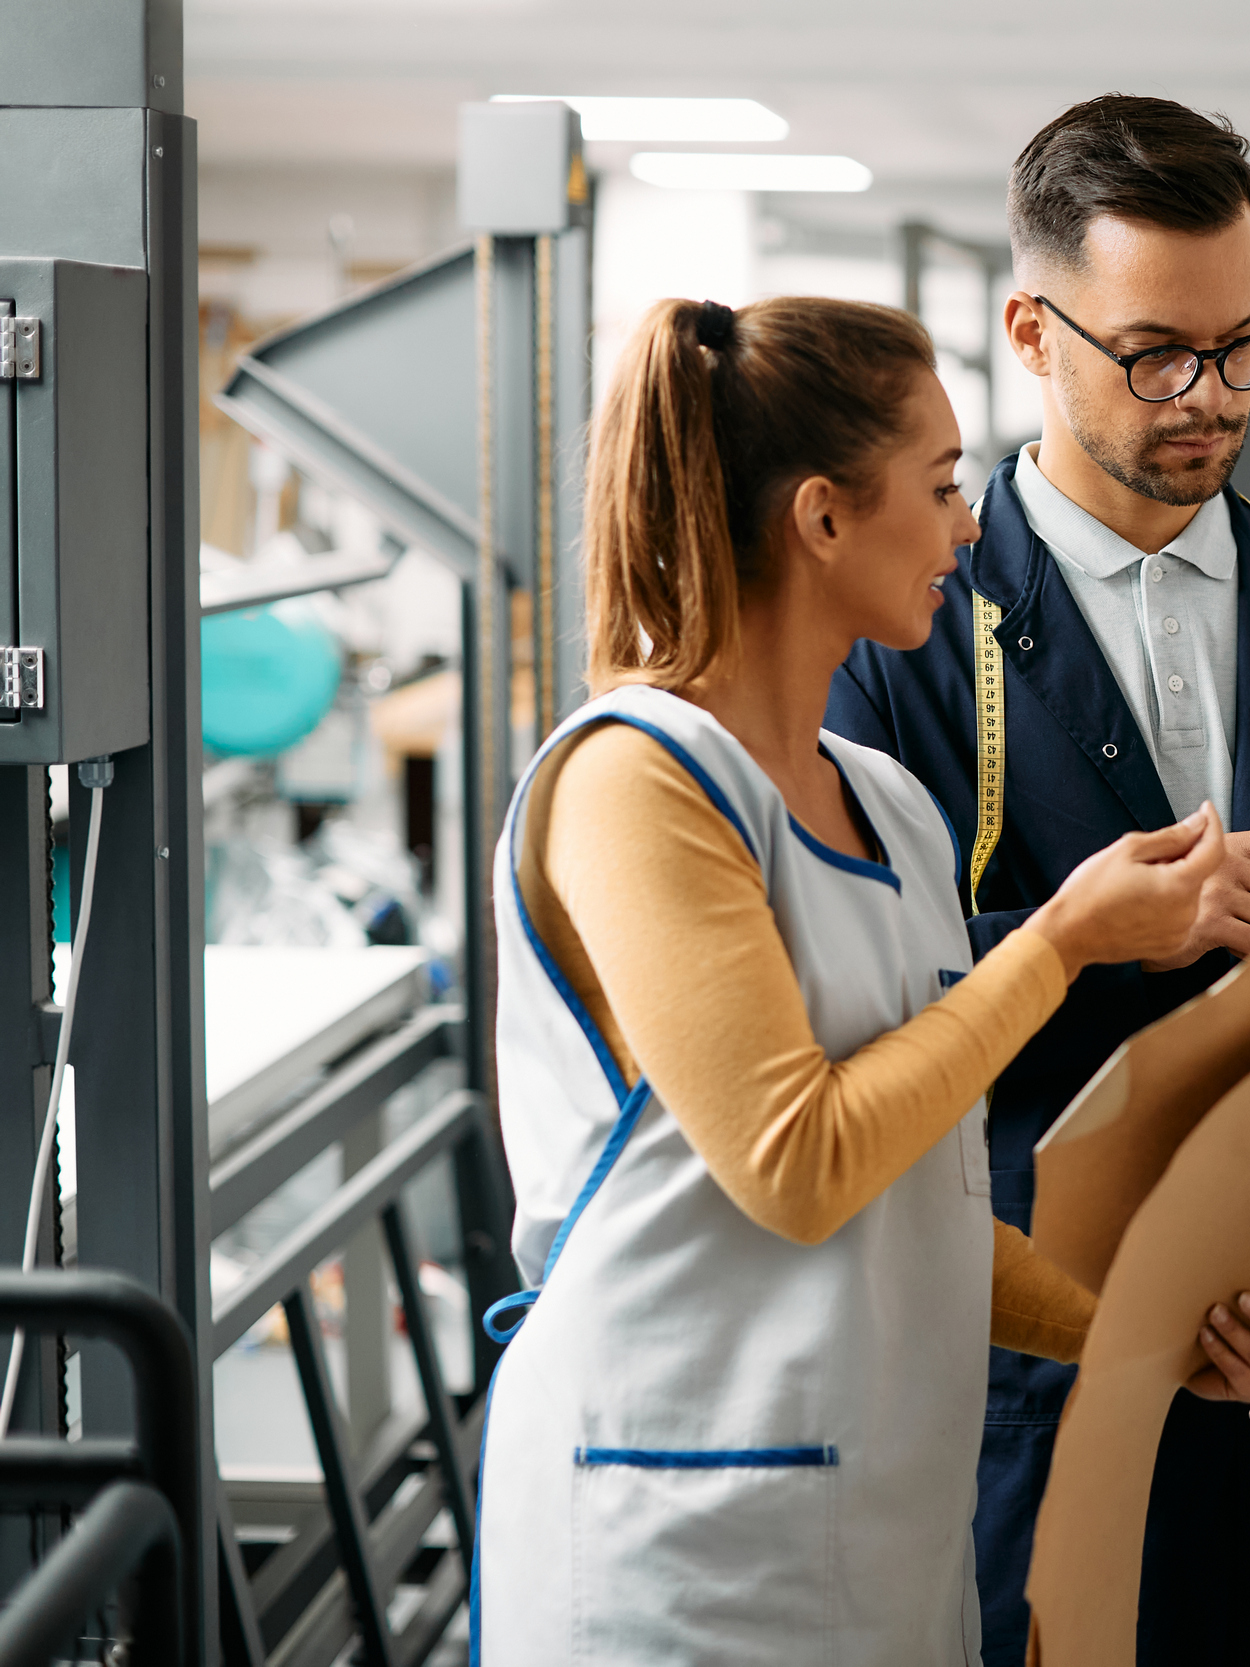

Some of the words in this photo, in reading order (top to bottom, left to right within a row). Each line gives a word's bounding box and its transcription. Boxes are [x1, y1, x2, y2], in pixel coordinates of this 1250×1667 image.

[985, 650, 994, 658] 50
[985, 664, 994, 672] 49
[986, 677, 994, 685] 48
[986, 690, 995, 698] 47
[986, 704, 996, 712] 46
[986, 718, 996, 726] 45
[987, 732, 996, 740] 44
[988, 746, 996, 754] 43
[987, 760, 996, 768] 42
[988, 774, 996, 782] 41
[986, 788, 995, 797] 40
[986, 802, 995, 812] 39
[986, 816, 995, 825] 38
[984, 830, 993, 839] 37
